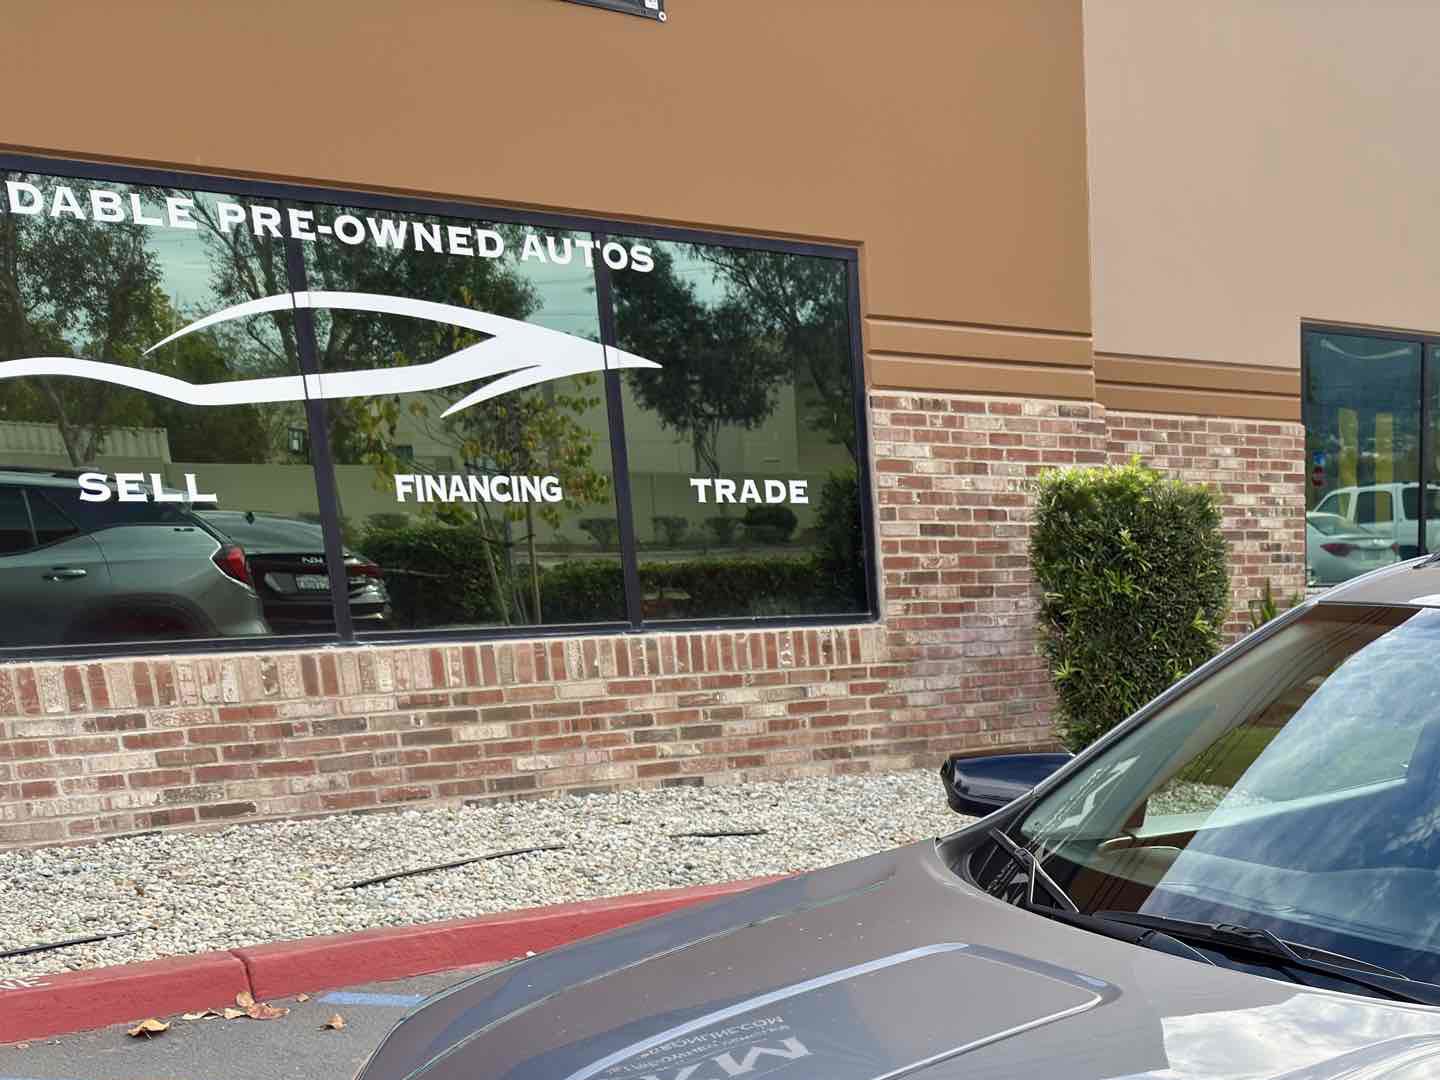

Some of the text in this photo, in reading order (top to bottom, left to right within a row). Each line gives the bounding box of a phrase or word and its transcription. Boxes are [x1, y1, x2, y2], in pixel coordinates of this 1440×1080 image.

[0, 180, 655, 274] DABLE PRE-OWNED AUTOS
[78, 471, 218, 503] SELL
[394, 473, 563, 504] FINANCING
[690, 478, 809, 505] TRADE
